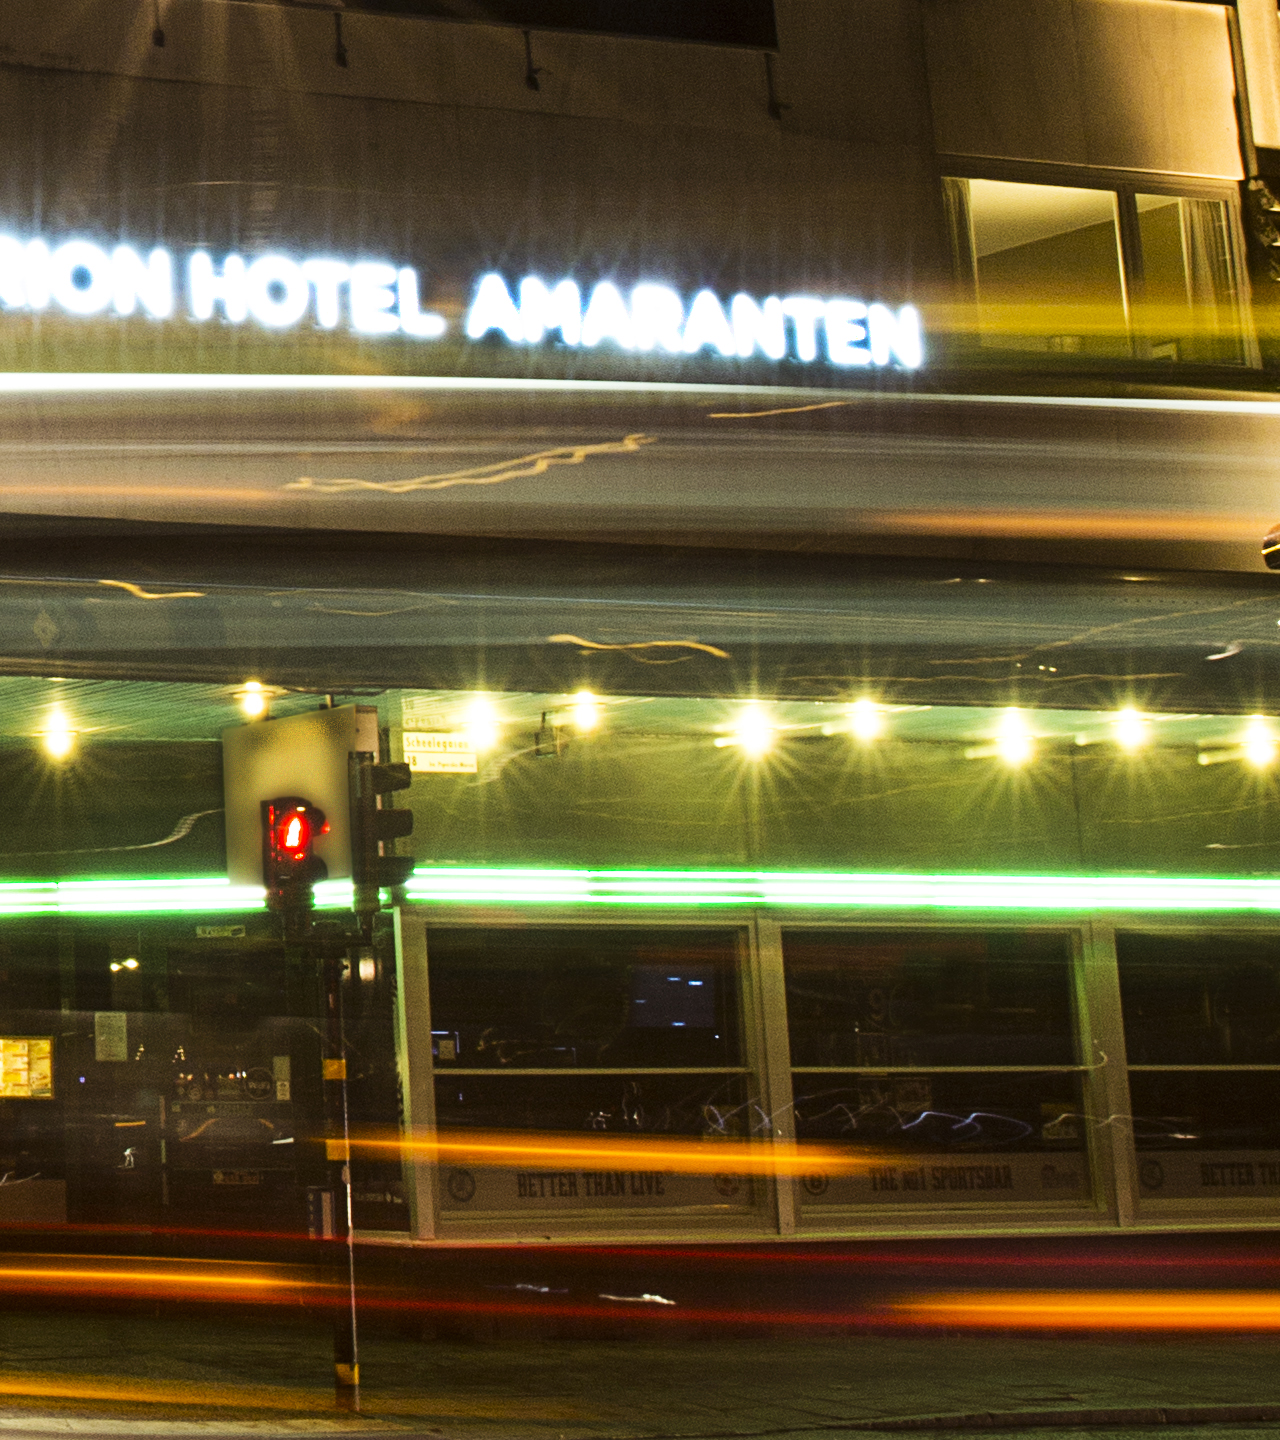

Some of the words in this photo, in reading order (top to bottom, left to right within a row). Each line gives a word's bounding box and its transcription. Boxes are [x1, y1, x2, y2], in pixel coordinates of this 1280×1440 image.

[189, 248, 446, 337] HOTEL
[465, 272, 923, 369] AMARANTEN
[517, 1172, 578, 1198] BETTER
[582, 1171, 626, 1197] THAN
[1200, 1161, 1255, 1187] BETTER
